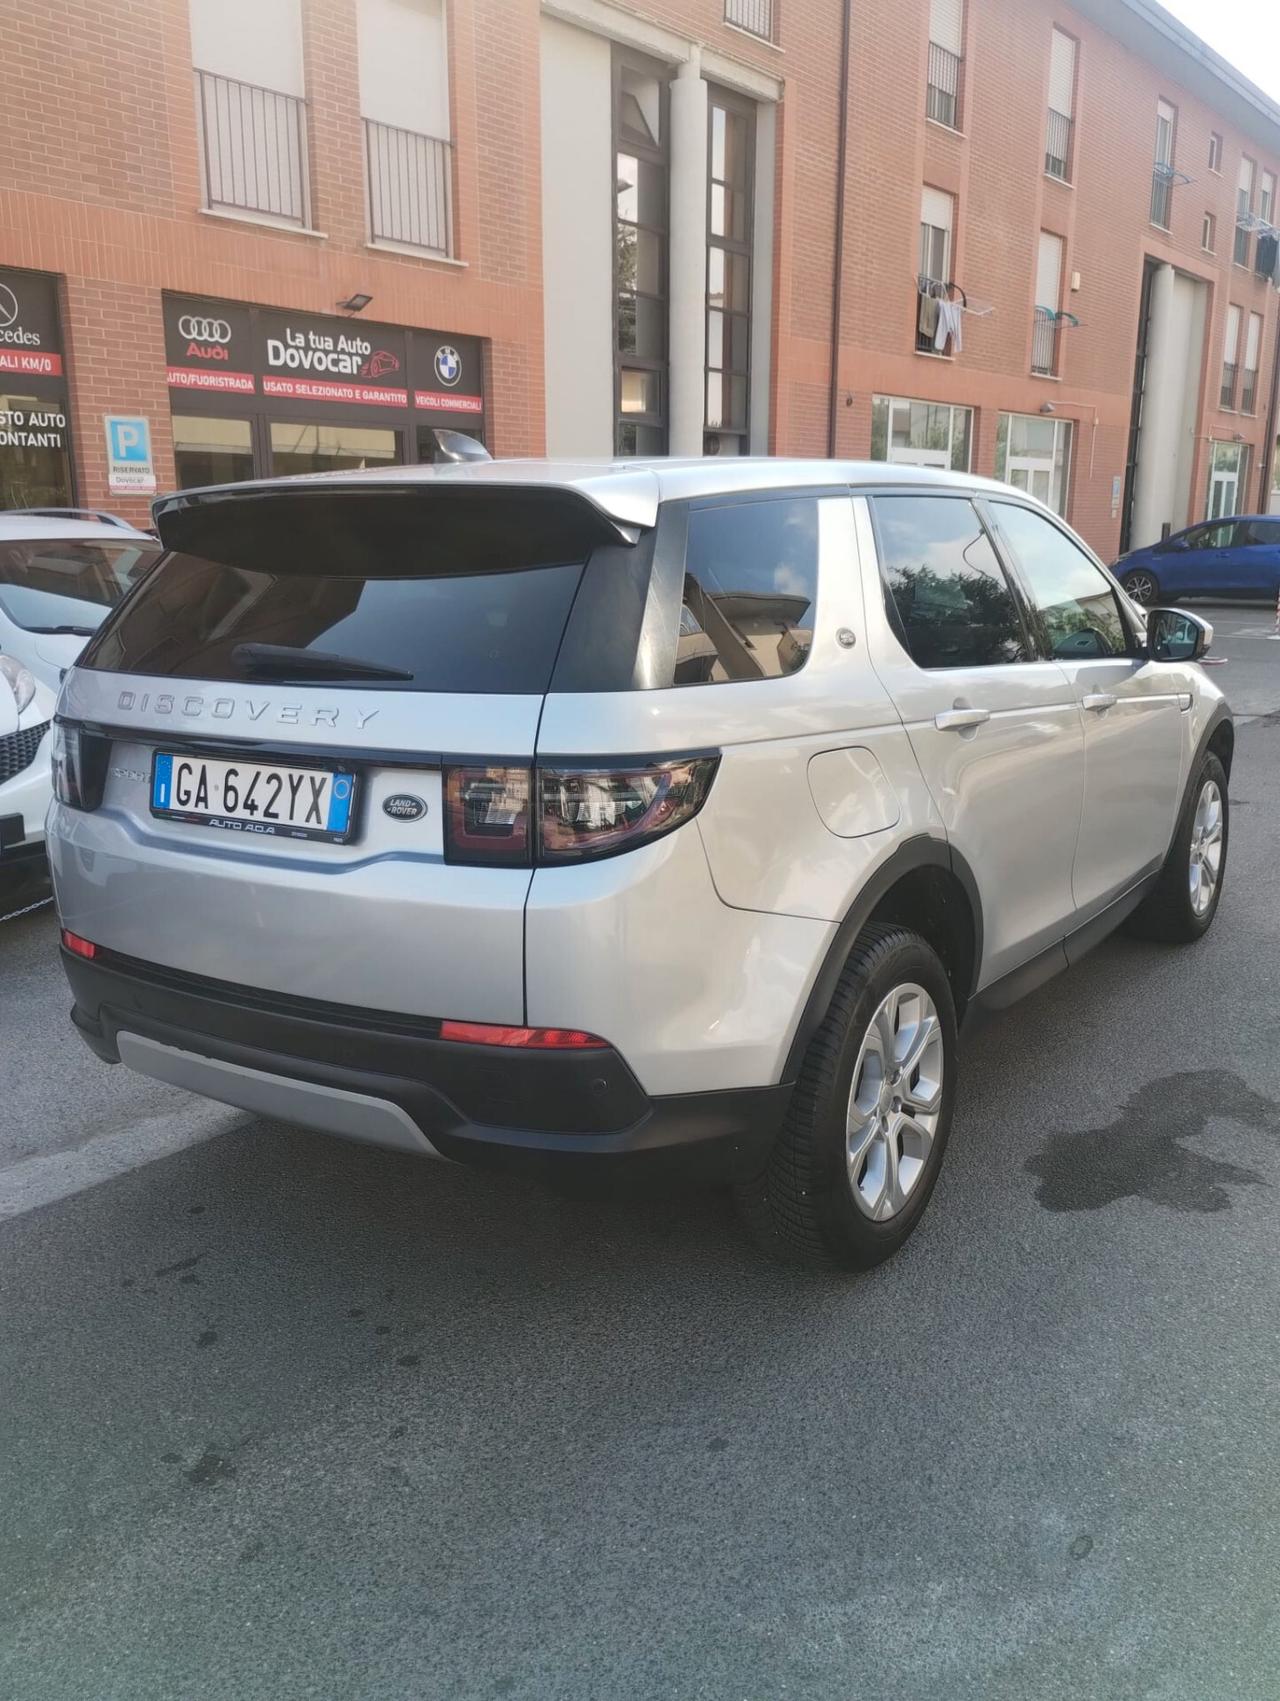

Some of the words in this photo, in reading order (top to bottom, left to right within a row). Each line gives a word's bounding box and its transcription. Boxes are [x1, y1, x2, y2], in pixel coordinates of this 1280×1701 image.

[286, 327, 305, 347] La
[308, 330, 334, 351] tua
[337, 334, 371, 355] Auto
[186, 342, 229, 360] Audi
[267, 339, 362, 375] Dovocar
[21, 357, 52, 372] KM/0
[167, 371, 254, 390] UTO/FUORISTRADA
[263, 381, 293, 393] USATO
[295, 383, 353, 399] SELEZIONATO
[355, 389, 361, 400] E
[362, 390, 407, 404] GARANTITO
[415, 395, 440, 407] VEICOLI
[440, 398, 482, 411] COMMERCIALI
[28, 412, 66, 428] AUTO
[117, 425, 138, 458] P
[112, 466, 151, 474] RISERVATO
[117, 691, 380, 730] DISCOVERY
[176, 763, 209, 809] GA
[223, 768, 327, 824] 642YX
[390, 799, 411, 807] LAND
[391, 806, 417, 816] ROVER
[208, 818, 242, 830] AUTO
